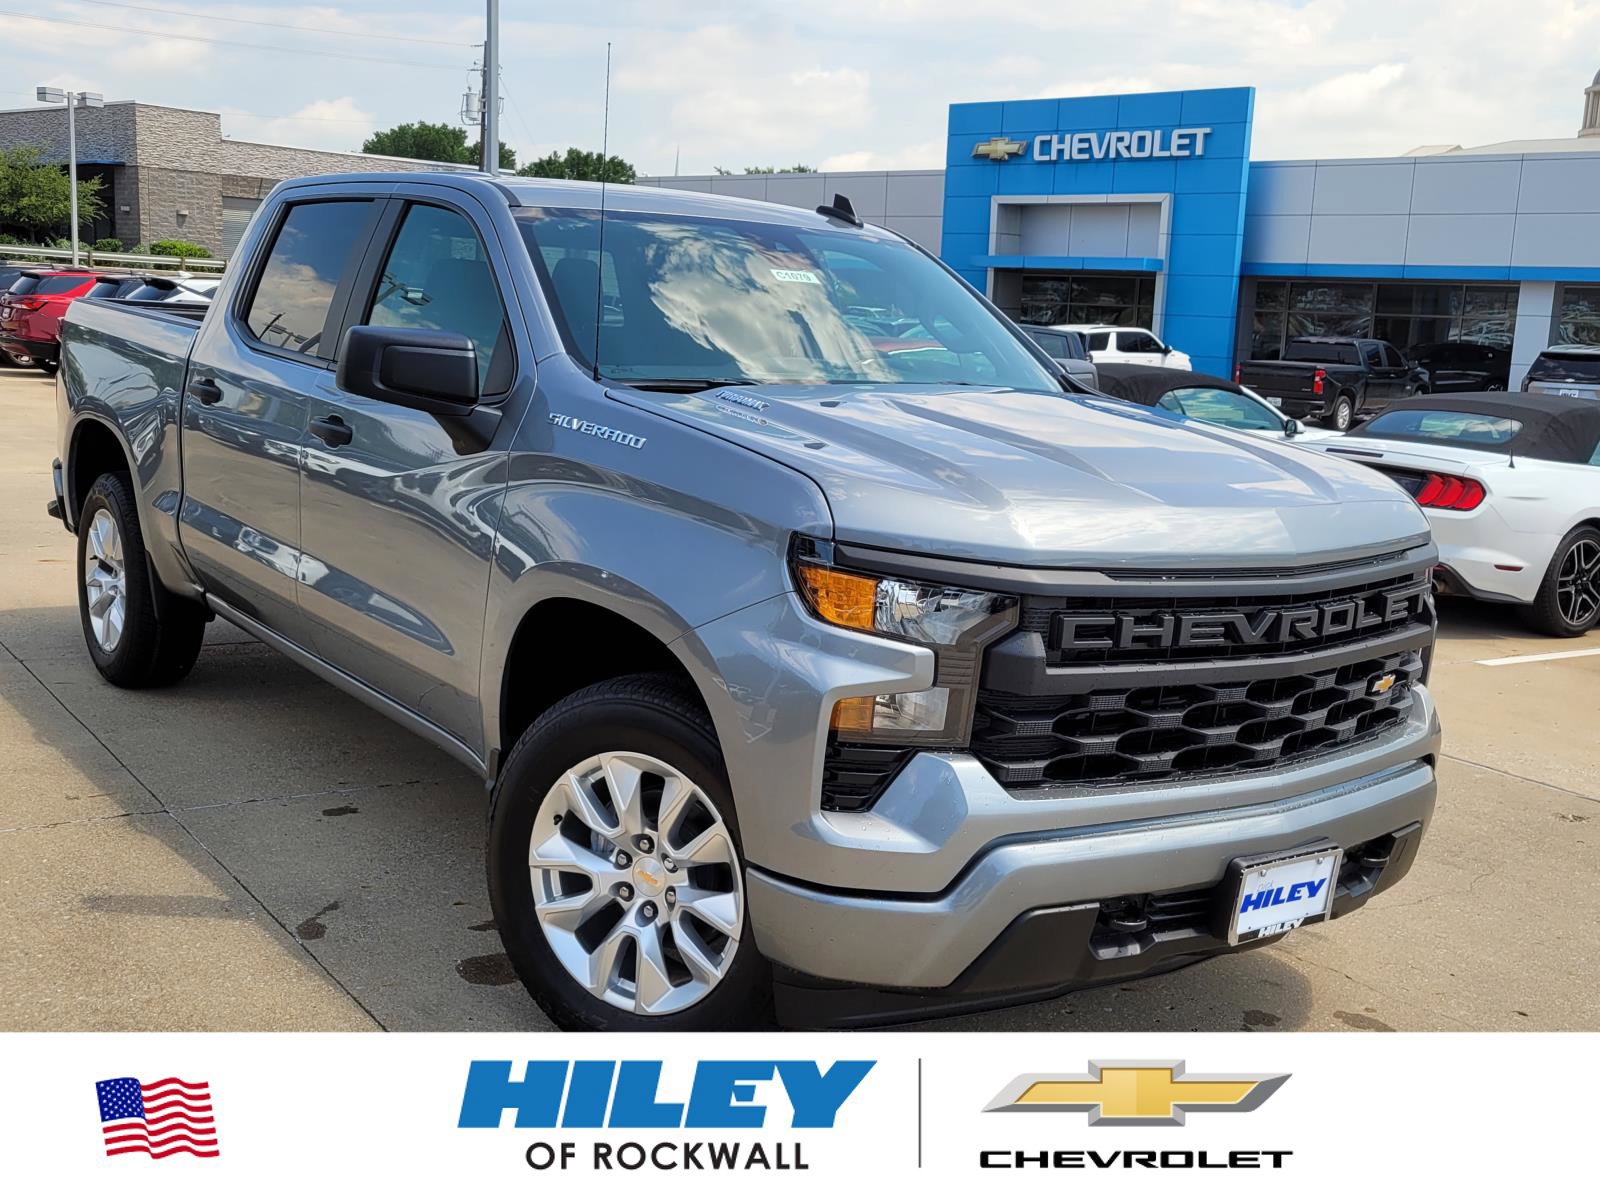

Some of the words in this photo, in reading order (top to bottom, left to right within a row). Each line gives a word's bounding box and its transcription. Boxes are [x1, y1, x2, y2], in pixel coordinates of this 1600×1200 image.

[1033, 128, 1212, 161] CHEVROLET
[549, 413, 647, 449] SILVERADO
[1240, 878, 1327, 913] HILEY
